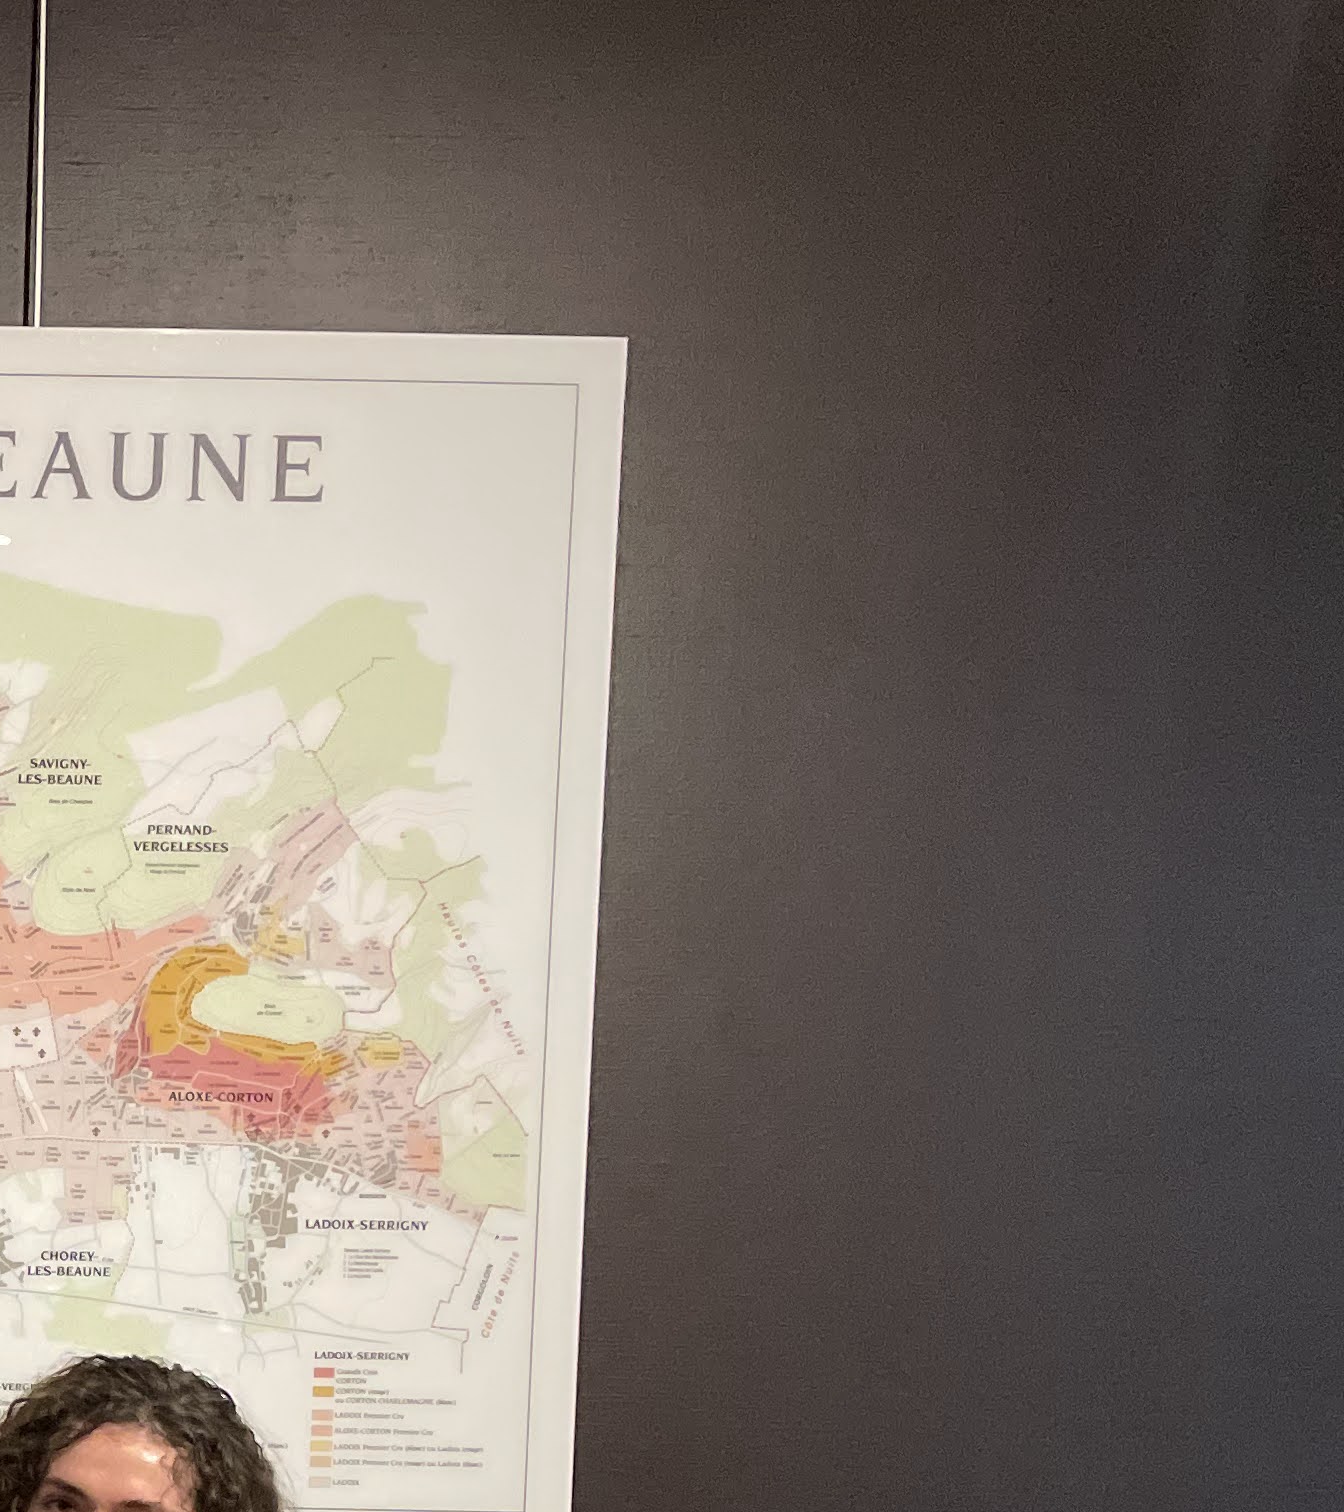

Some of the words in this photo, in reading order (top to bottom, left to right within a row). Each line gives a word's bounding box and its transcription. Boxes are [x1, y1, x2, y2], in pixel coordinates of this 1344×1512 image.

[29, 758, 92, 772] SAVIGNY-
[18, 774, 103, 787] LES-BEAUNE
[147, 825, 217, 837] PERNAND-
[133, 841, 229, 853] VERGELESSES
[169, 1091, 274, 1104] ALOXE-CORTON
[305, 1219, 429, 1232] LADOIX-SERRIGNY
[40, 1250, 99, 1263] CHOREY-
[27, 1265, 111, 1278] LES-BEAUNE
[314, 1351, 410, 1360] LADOIX-SERRIGNY
